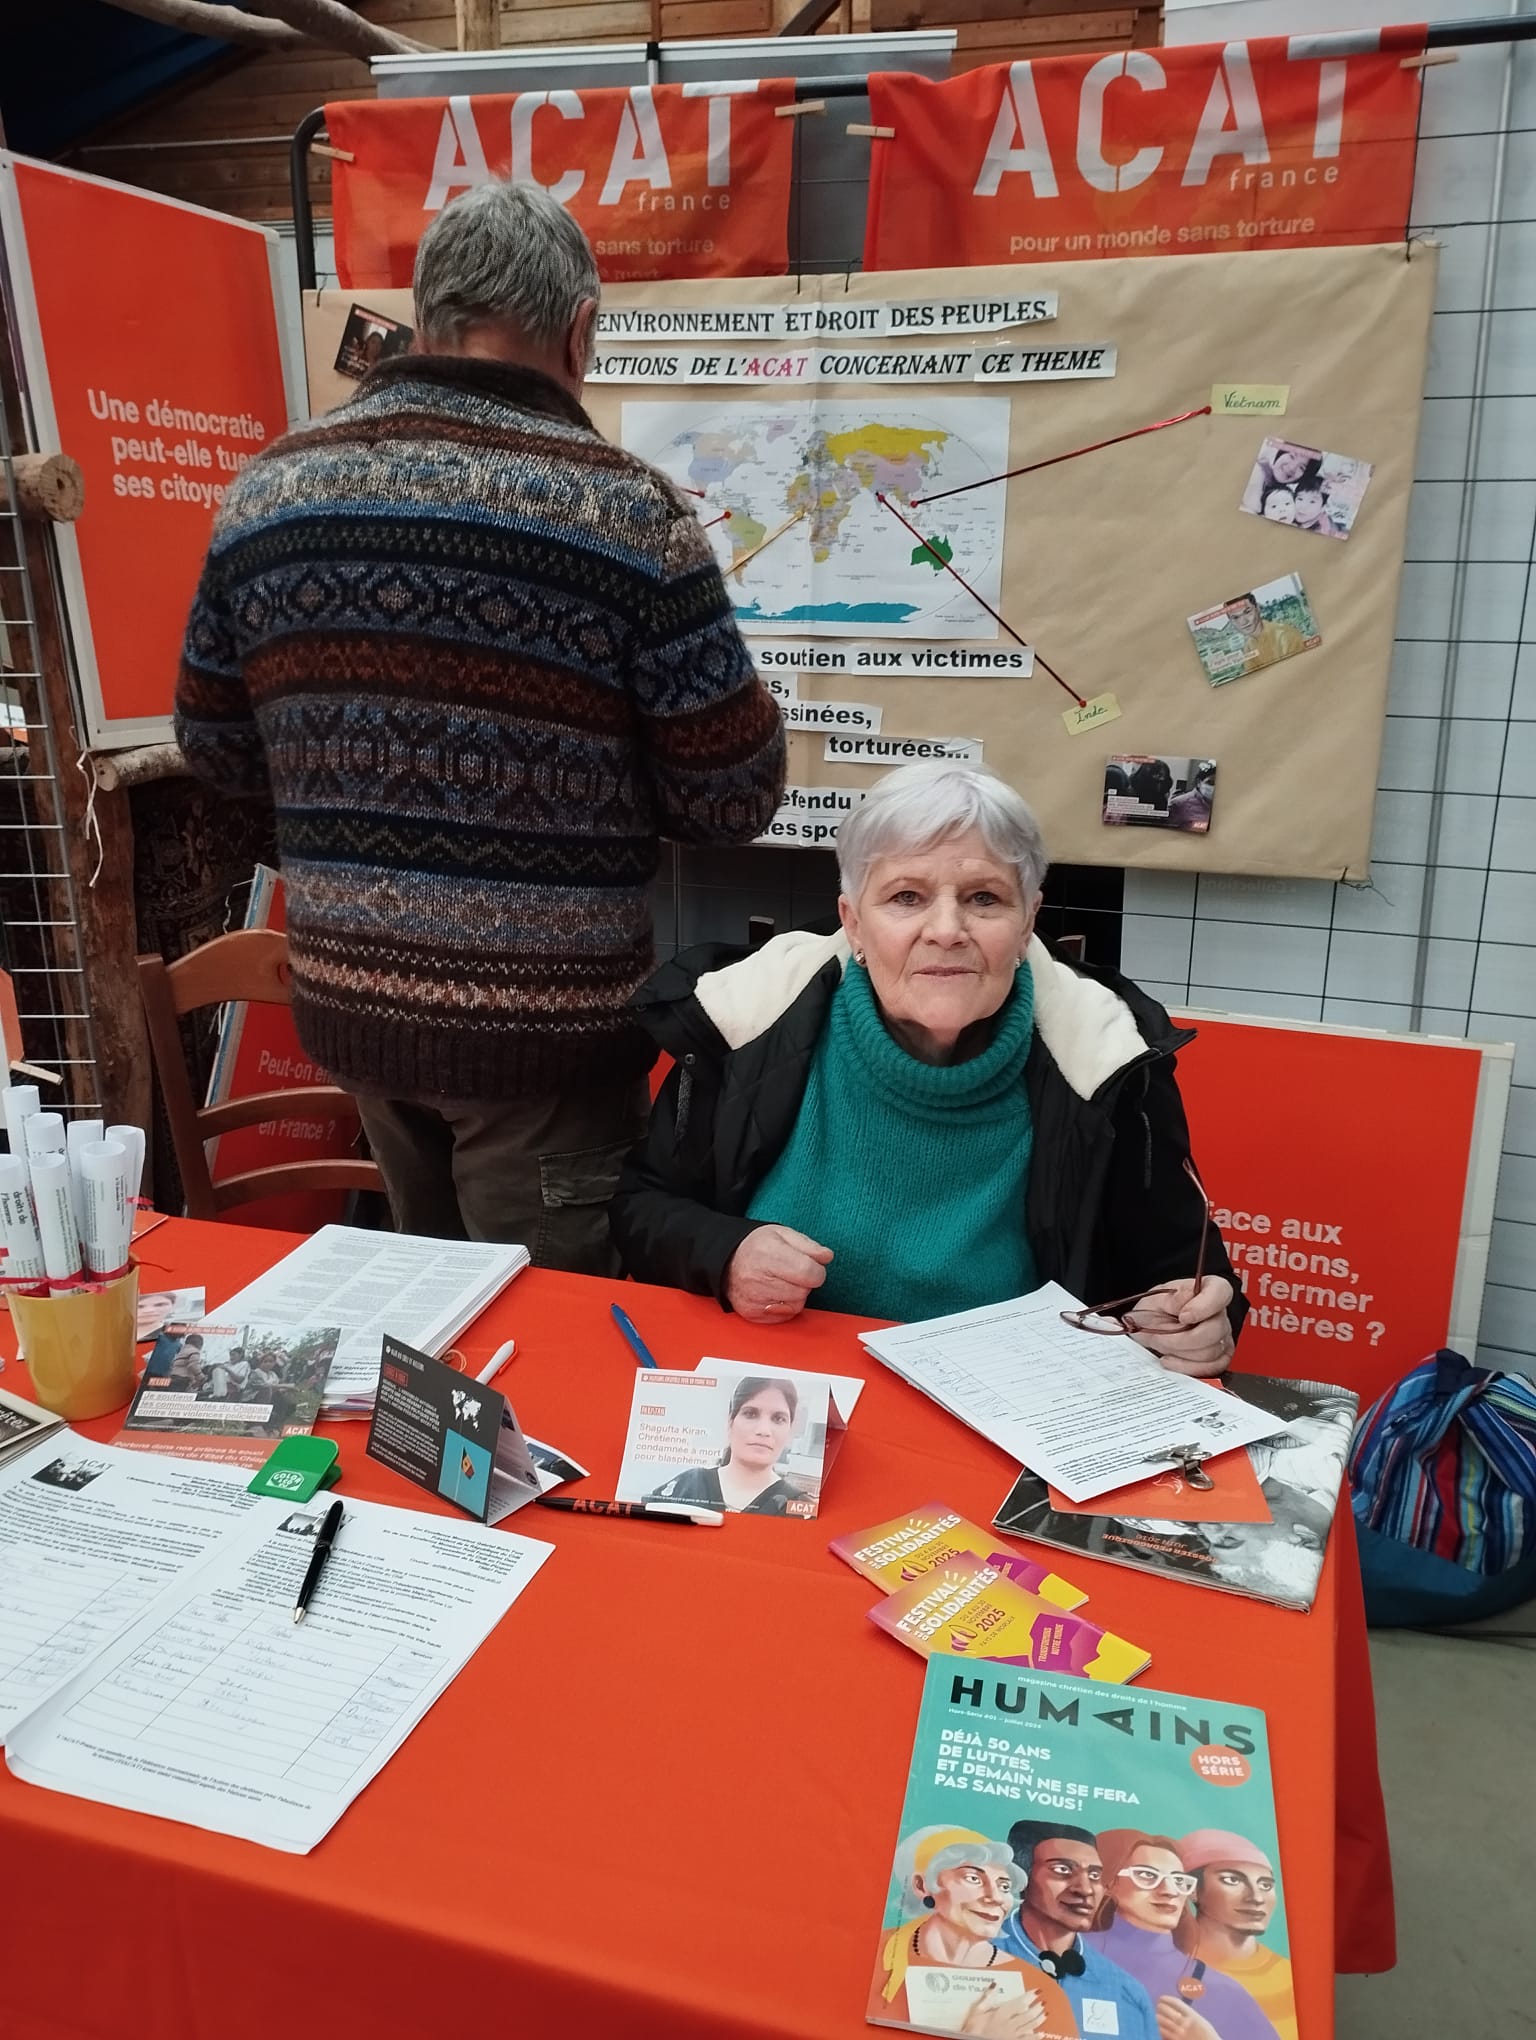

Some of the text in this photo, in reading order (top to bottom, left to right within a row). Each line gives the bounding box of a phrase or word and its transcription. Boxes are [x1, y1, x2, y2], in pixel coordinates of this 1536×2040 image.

[973, 27, 1381, 198] ACAT
[423, 79, 759, 210] ACAT
[1230, 163, 1339, 191] france
[638, 192, 731, 212] france
[596, 238, 715, 256] sans torture
[1009, 215, 1316, 255] pour un monde sans torture
[597, 300, 1048, 333] ENVIRONNEMENT ET DROIT DES PEUPLES
[690, 357, 721, 376] DE
[727, 356, 809, 377] L'ACAT
[819, 353, 972, 376] CONCERNANT
[981, 352, 1013, 374] CE
[1020, 349, 1106, 373] THEME
[1224, 391, 1281, 408] Vietnam
[87, 388, 266, 441] Une démocratie
[111, 436, 213, 469] peut-elle
[112, 473, 231, 509] ses citoye
[761, 648, 1023, 669] soutien aux victimes
[1073, 705, 1109, 724] Inde
[829, 736, 970, 760] torturées...
[258, 1050, 313, 1081] Peut-on
[279, 1119, 324, 1140] France
[327, 1119, 336, 1141] ?
[13, 1191, 25, 1214] droits
[1281, 1216, 1343, 1246] aux
[1258, 1273, 1373, 1314] fermer
[1365, 1320, 1386, 1347] ?
[285, 1427, 310, 1436] ACAT
[699, 1448, 721, 1457] mort
[572, 1498, 635, 1516] ACAT
[789, 1503, 816, 1514] ACAT
[853, 1525, 921, 1563] FESTIVAL
[874, 1514, 962, 1568] SOLIDARITÉS
[928, 1548, 960, 1568] 2025
[896, 1582, 960, 1634] FESTIVAL
[918, 1567, 999, 1638] SOLIDARITÉS
[975, 1608, 1006, 1632] 2025
[1017, 1676, 1188, 1712] magazine chrétien des droits de l'homme
[950, 1675, 1256, 1756] HUMAINS
[939, 1743, 1035, 1774] DE LUTTES,
[941, 1728, 1051, 1761] DÉJÀ 50 ANS
[1198, 1755, 1241, 1767] HORS
[1200, 1765, 1245, 1778] SÉRIE
[934, 1773, 969, 1790] PAS
[972, 1779, 1022, 1800] SANS
[936, 1758, 1141, 1805] ET DEMAIN NE SE FERA
